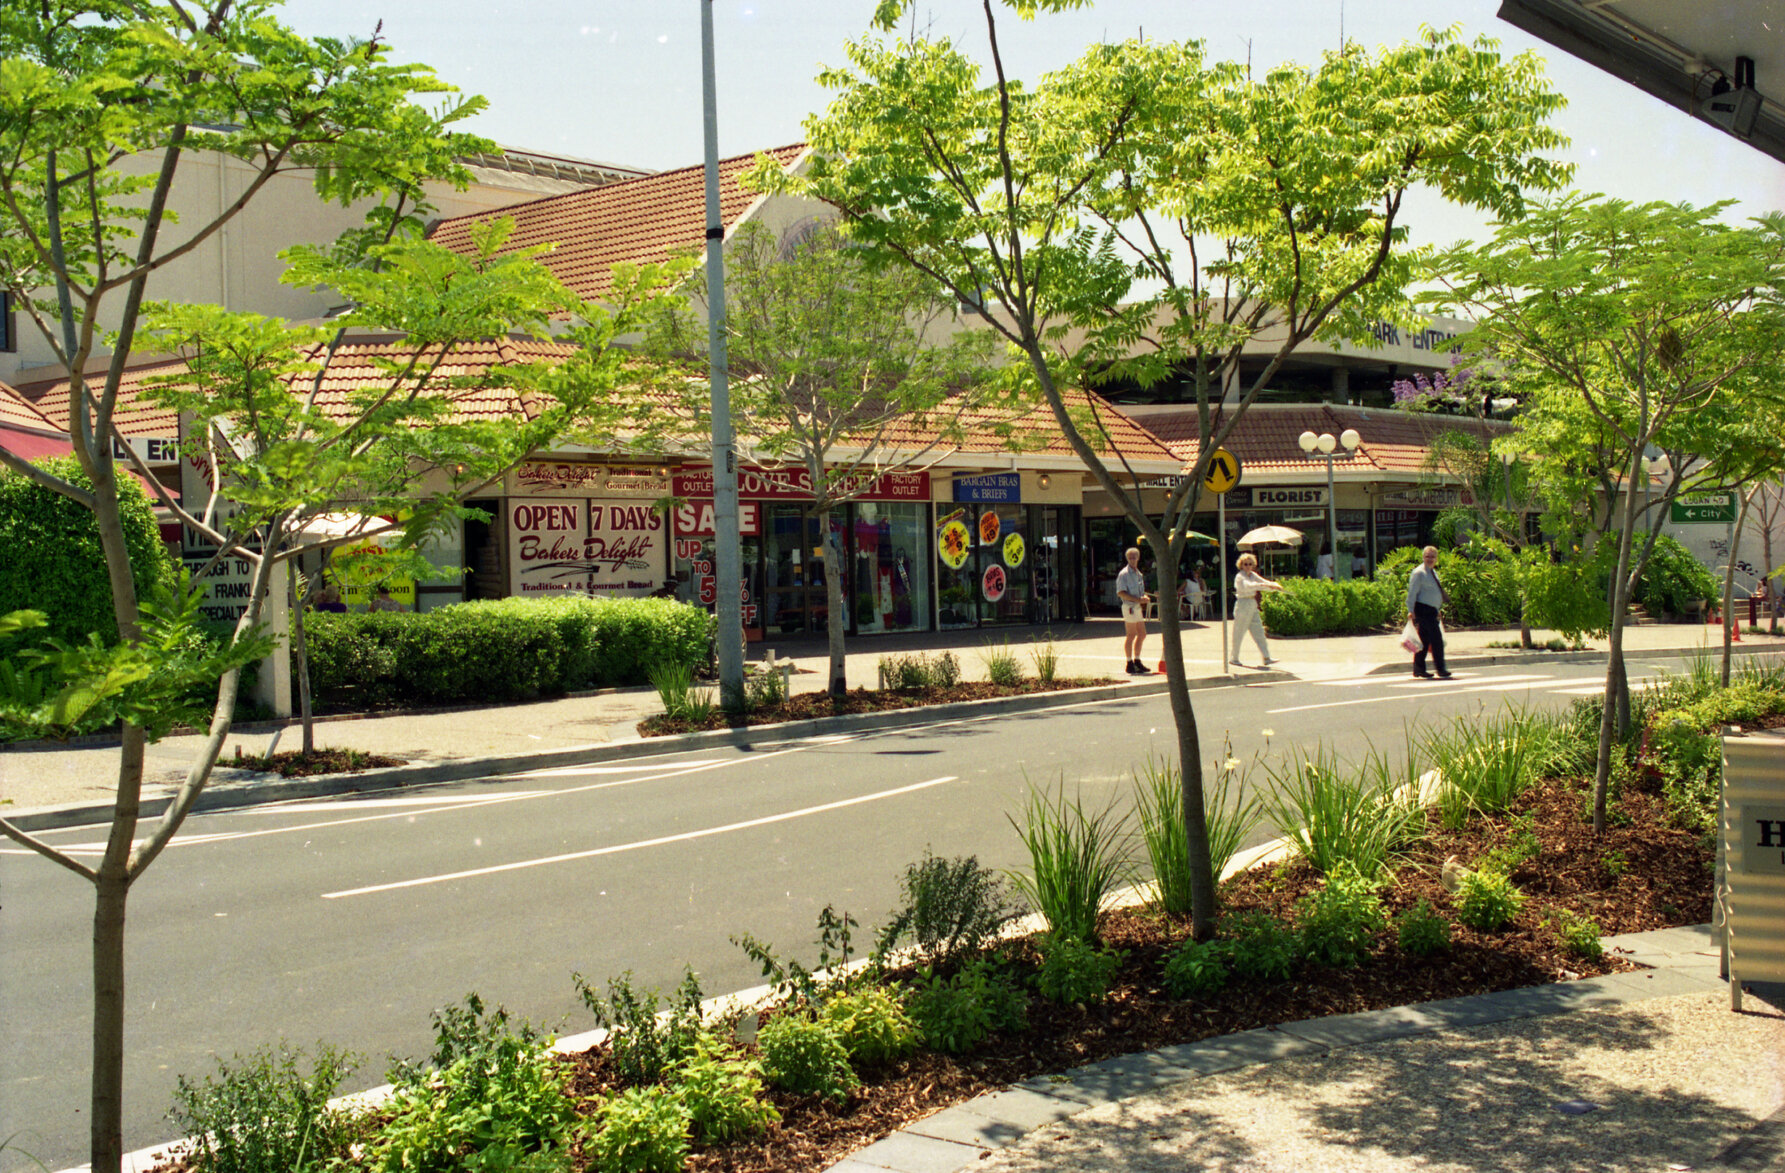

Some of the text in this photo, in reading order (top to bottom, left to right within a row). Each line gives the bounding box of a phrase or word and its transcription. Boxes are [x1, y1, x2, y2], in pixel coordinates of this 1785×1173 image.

[606, 480, 667, 490] Gourmet Bread
[891, 474, 922, 485] FACTORY
[960, 475, 1018, 487] BARGAIN BRAS
[892, 486, 920, 496] OUTLET
[972, 488, 1008, 499] & BRIEFS
[1258, 491, 1322, 503] FLORIST
[513, 504, 662, 532] OPEN 7 DAYS
[677, 503, 756, 533] SAE
[1700, 509, 1721, 519] City
[519, 535, 653, 573] Bakers Delight
[676, 539, 703, 560] UP
[235, 560, 250, 575] TO
[692, 560, 711, 575] TO
[575, 582, 583, 590] &
[627, 580, 653, 589] Bread
[700, 575, 750, 605] 5%
